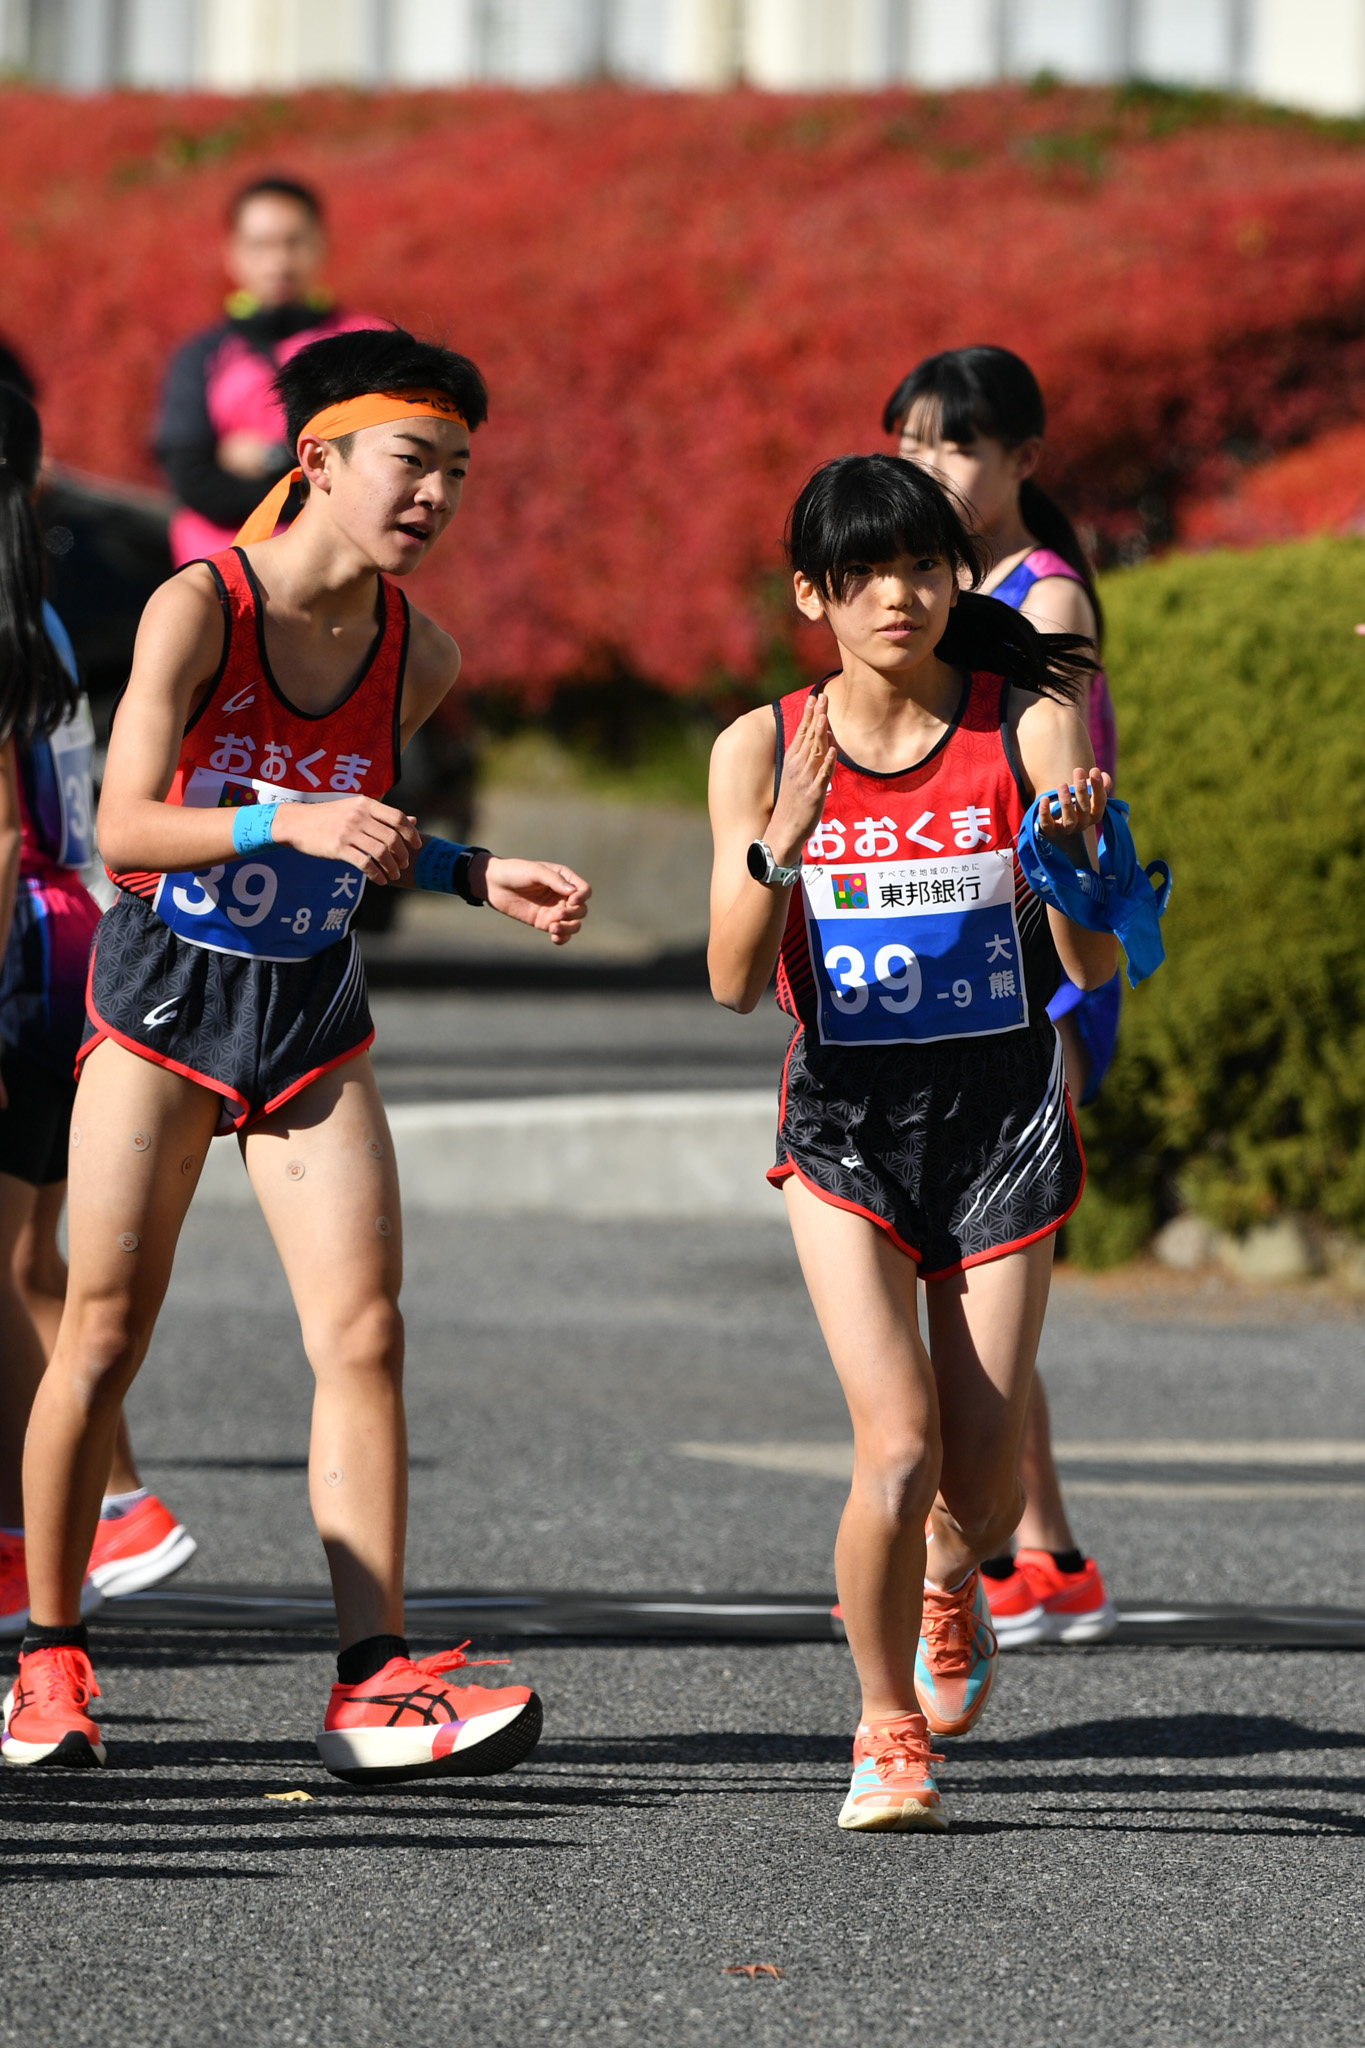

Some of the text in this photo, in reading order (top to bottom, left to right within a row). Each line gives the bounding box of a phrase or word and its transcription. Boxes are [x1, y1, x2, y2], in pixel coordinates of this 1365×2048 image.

[209, 733, 372, 792] おおくま
[807, 805, 992, 860] おおくま
[877, 863, 981, 879] すべてを地域のために
[878, 875, 982, 909] 東邦銀行
[321, 872, 358, 931] 大熊
[985, 933, 1016, 1000] 大熊
